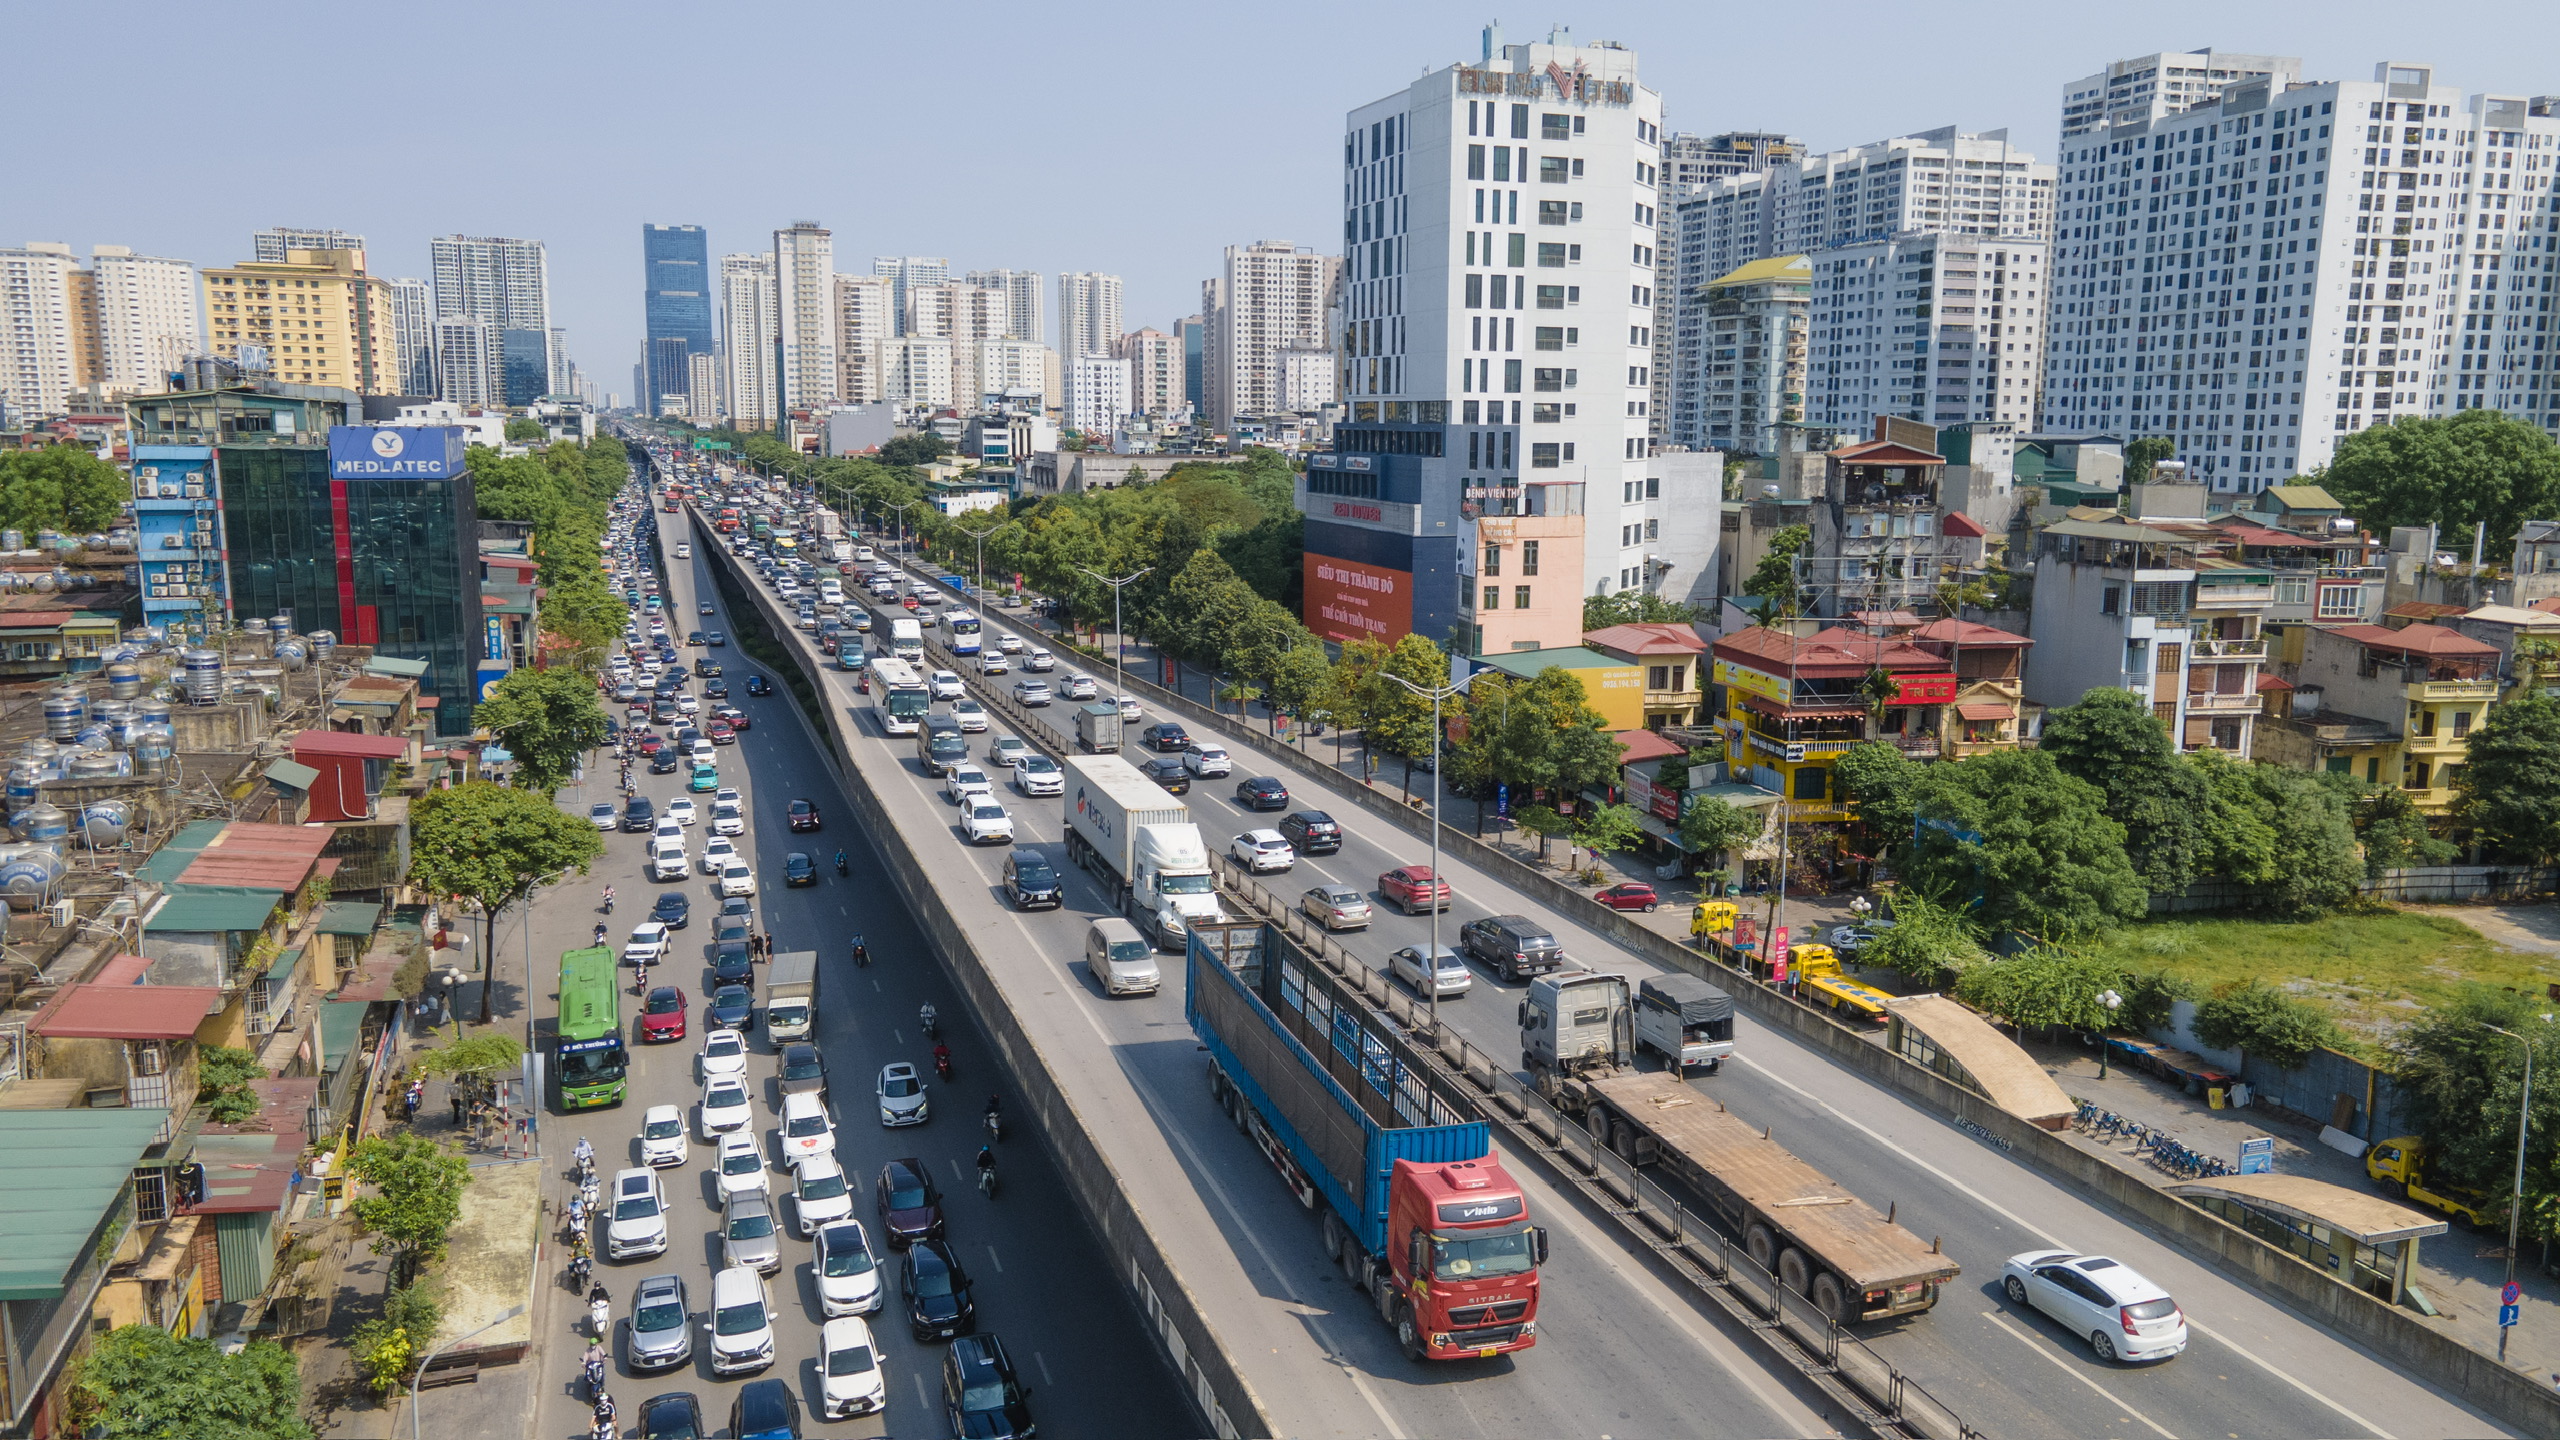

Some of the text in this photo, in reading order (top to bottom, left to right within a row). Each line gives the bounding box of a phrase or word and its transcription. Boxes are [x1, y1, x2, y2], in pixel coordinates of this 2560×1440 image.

[336, 460, 442, 474] MEDLATEC
[1466, 484, 1486, 501] BỆNH
[1488, 484, 1505, 501] VIỆN
[1333, 502, 1382, 521] ZEN TOWER
[1317, 563, 1394, 594] SIÊU THỊ THÀNH ĐÔ
[1322, 603, 1334, 619] THẾ
[1334, 606, 1348, 624] GIỚI
[1365, 618, 1387, 634] TRANG
[1907, 685, 1924, 697] TRÍ
[1468, 1293, 1511, 1304] SITRAK
